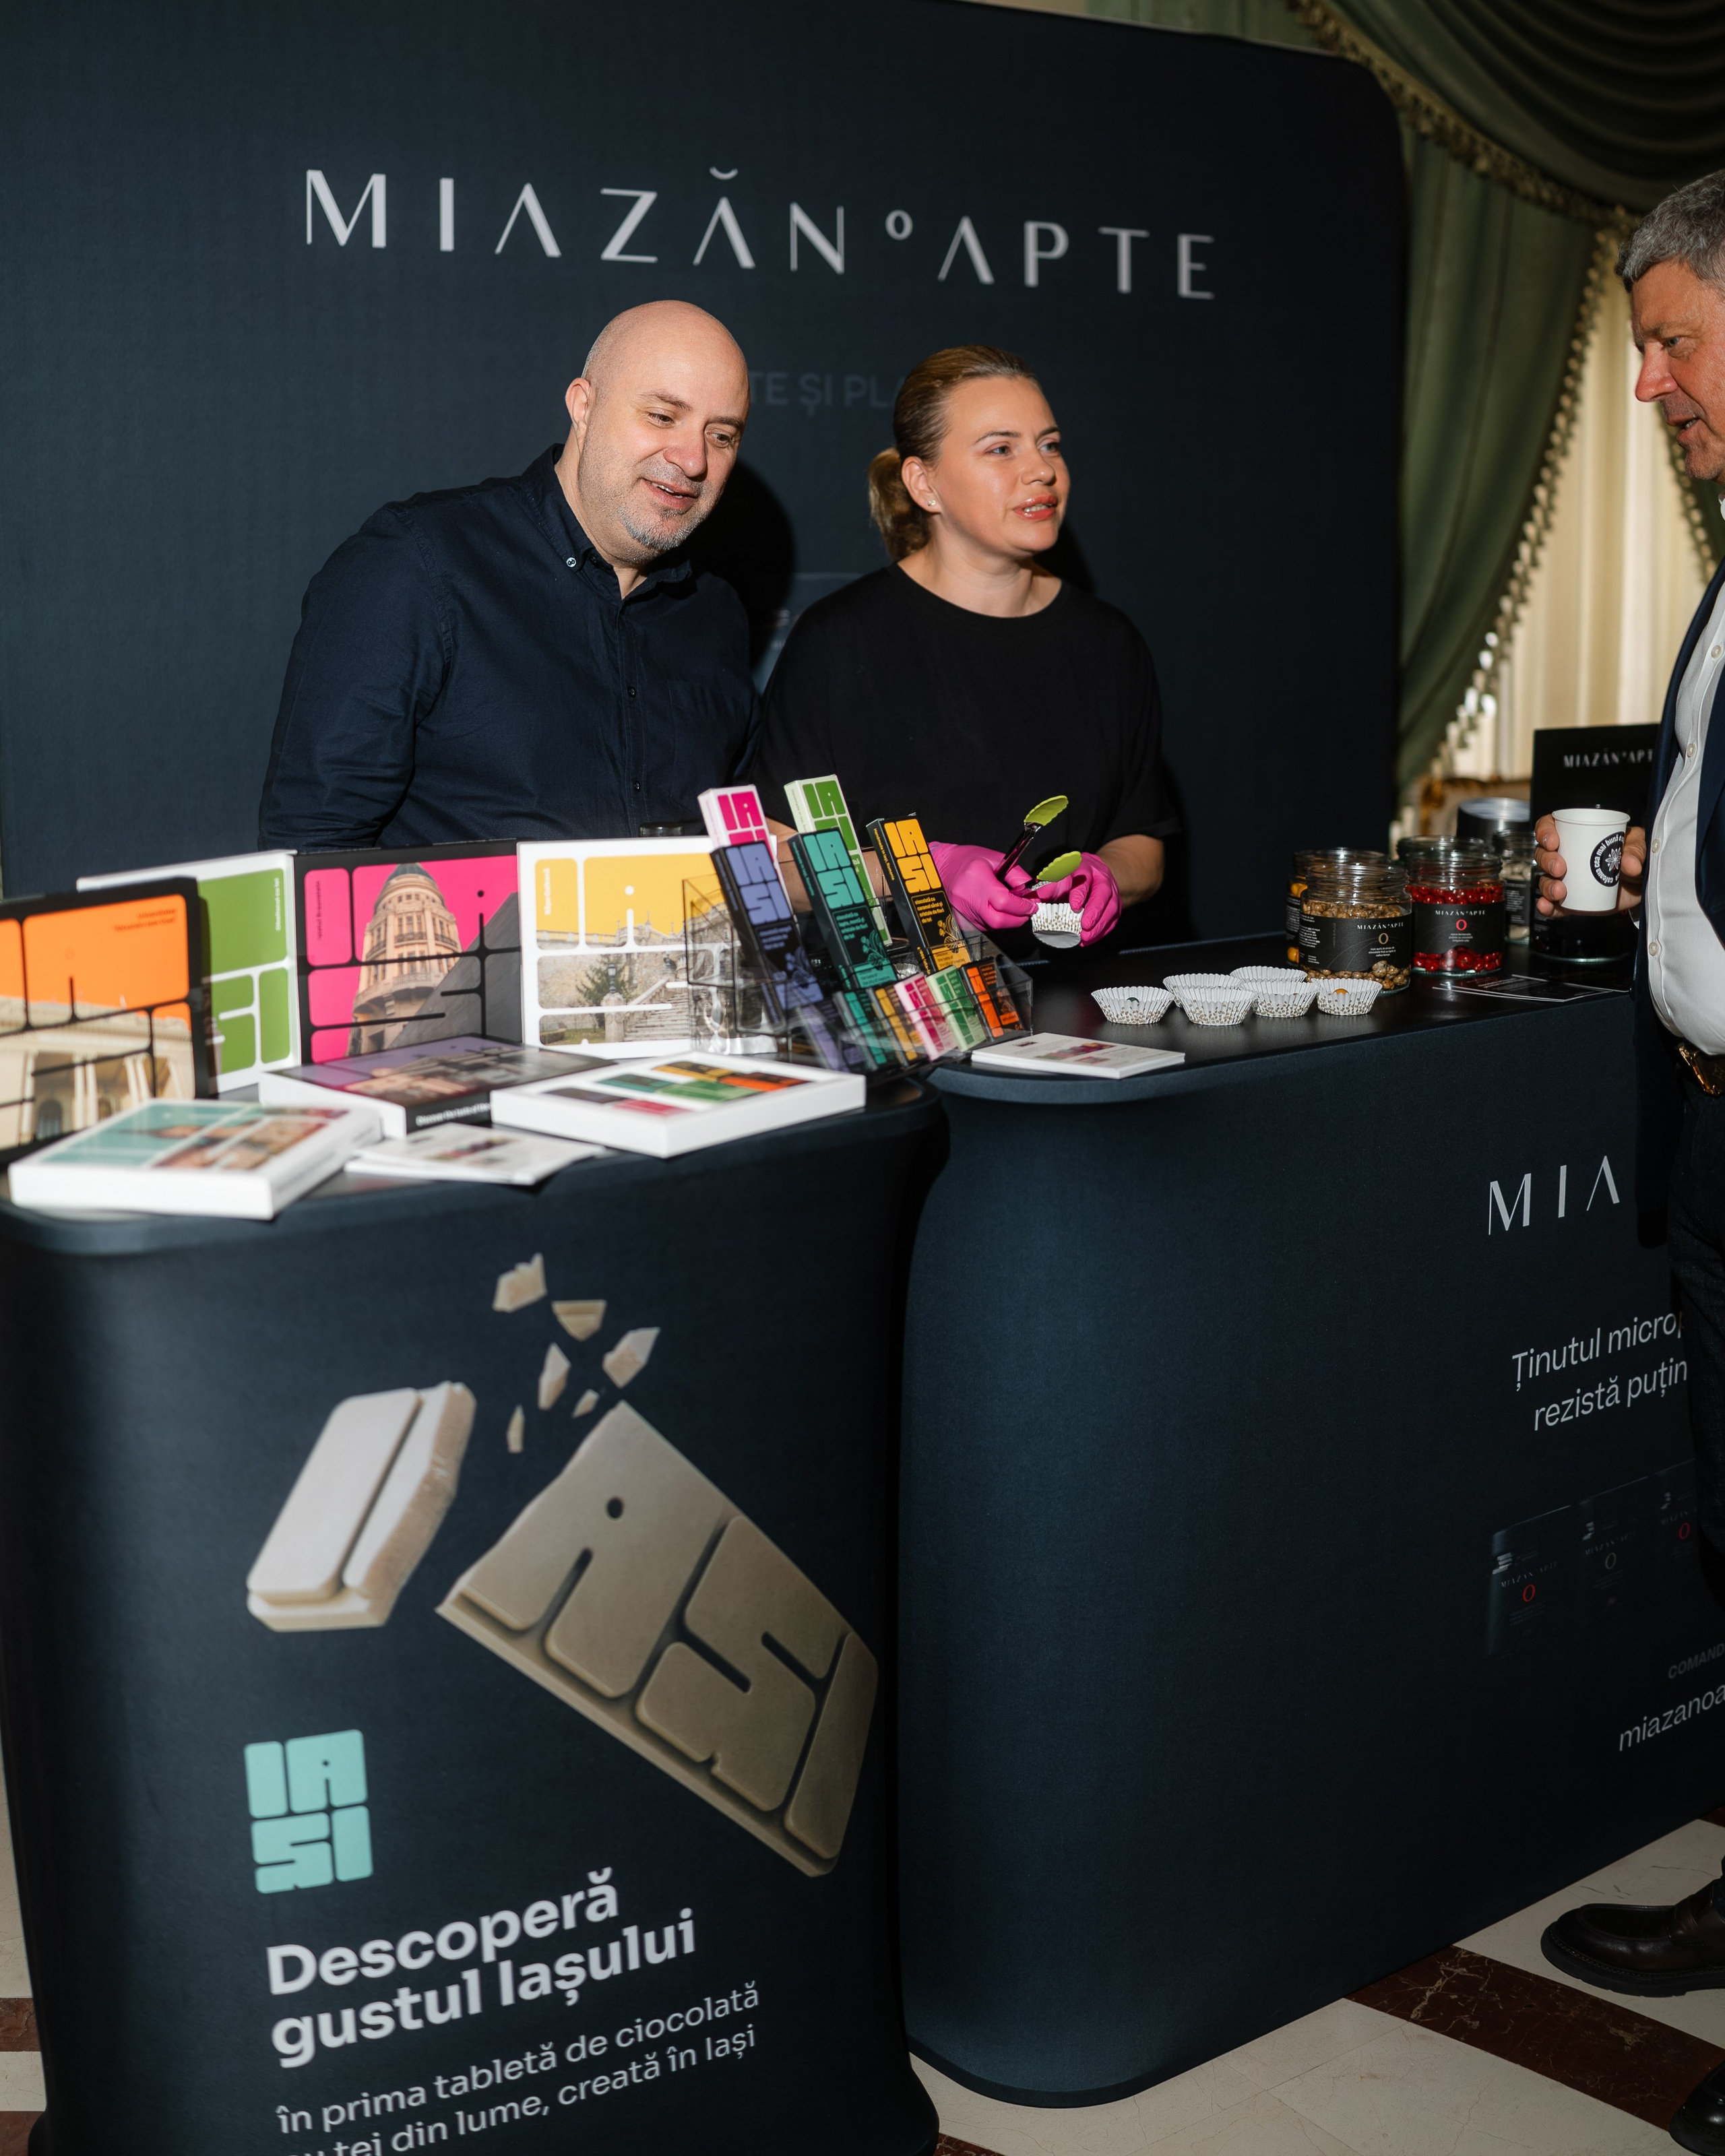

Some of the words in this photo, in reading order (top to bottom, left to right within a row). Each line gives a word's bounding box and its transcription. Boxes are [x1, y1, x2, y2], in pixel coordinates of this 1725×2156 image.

[873, 828, 885, 851] Handmade
[1488, 1155, 1620, 1236] MIA
[1511, 1327, 1601, 1392] Ținutul
[1534, 1375, 1621, 1431] rezistă
[1627, 1357, 1687, 1407] puțin
[1668, 1643, 1725, 1680] COMAND
[1619, 1684, 1725, 1751] miazanoa
[266, 1866, 619, 1996] Descoperă
[271, 1967, 482, 2068] gustul
[499, 1907, 695, 2007] Iașului
[276, 2104, 313, 2134] în
[322, 2085, 427, 2133] prima
[433, 2041, 557, 2099] tabletă
[566, 2035, 608, 2062] de
[616, 1980, 759, 2048] ciocolată
[333, 2132, 383, 2156] tei
[391, 2118, 448, 2153] din
[455, 2096, 550, 2136] lume,
[559, 2052, 660, 2105] creată
[666, 2046, 697, 2072] în
[705, 2024, 755, 2061] Iași
